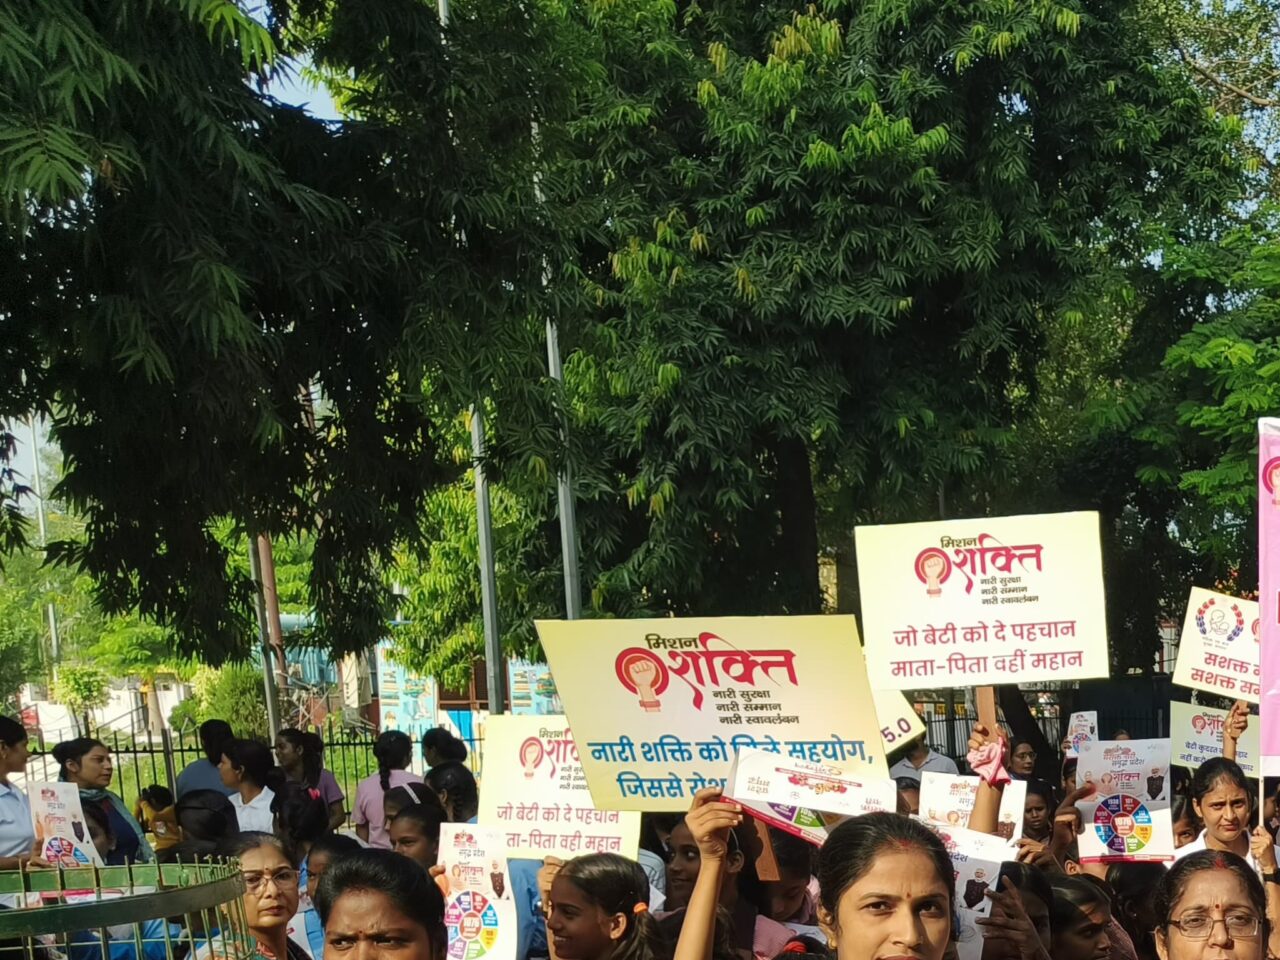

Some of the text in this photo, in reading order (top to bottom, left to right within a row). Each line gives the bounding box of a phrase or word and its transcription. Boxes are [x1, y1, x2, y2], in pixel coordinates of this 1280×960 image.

[940, 536, 977, 549] मिशन
[952, 533, 1044, 595] शक्ति
[981, 587, 998, 595] नारी
[982, 597, 999, 605] नारी
[645, 633, 698, 650] मिशन
[893, 620, 1077, 647] जो बेटी को दे पहचान
[668, 631, 800, 711] शक्ति
[890, 652, 988, 677] माता-पिता
[1030, 650, 1083, 670] महान
[1204, 651, 1251, 674] सशक्त
[1191, 667, 1237, 690] सशक्त
[712, 689, 770, 702] नारी सुरक्षा
[716, 702, 782, 712] नारी सम्मान
[719, 713, 800, 725] नारी स्वावलंबन
[880, 717, 912, 743] 5.0
[587, 734, 874, 764] नारी शक्ति को सहयोग,
[616, 771, 684, 798] जिससे
[497, 802, 619, 824] जो बेटी को दे पहचान
[505, 829, 556, 849] ता-पिता
[585, 836, 622, 853] महान
